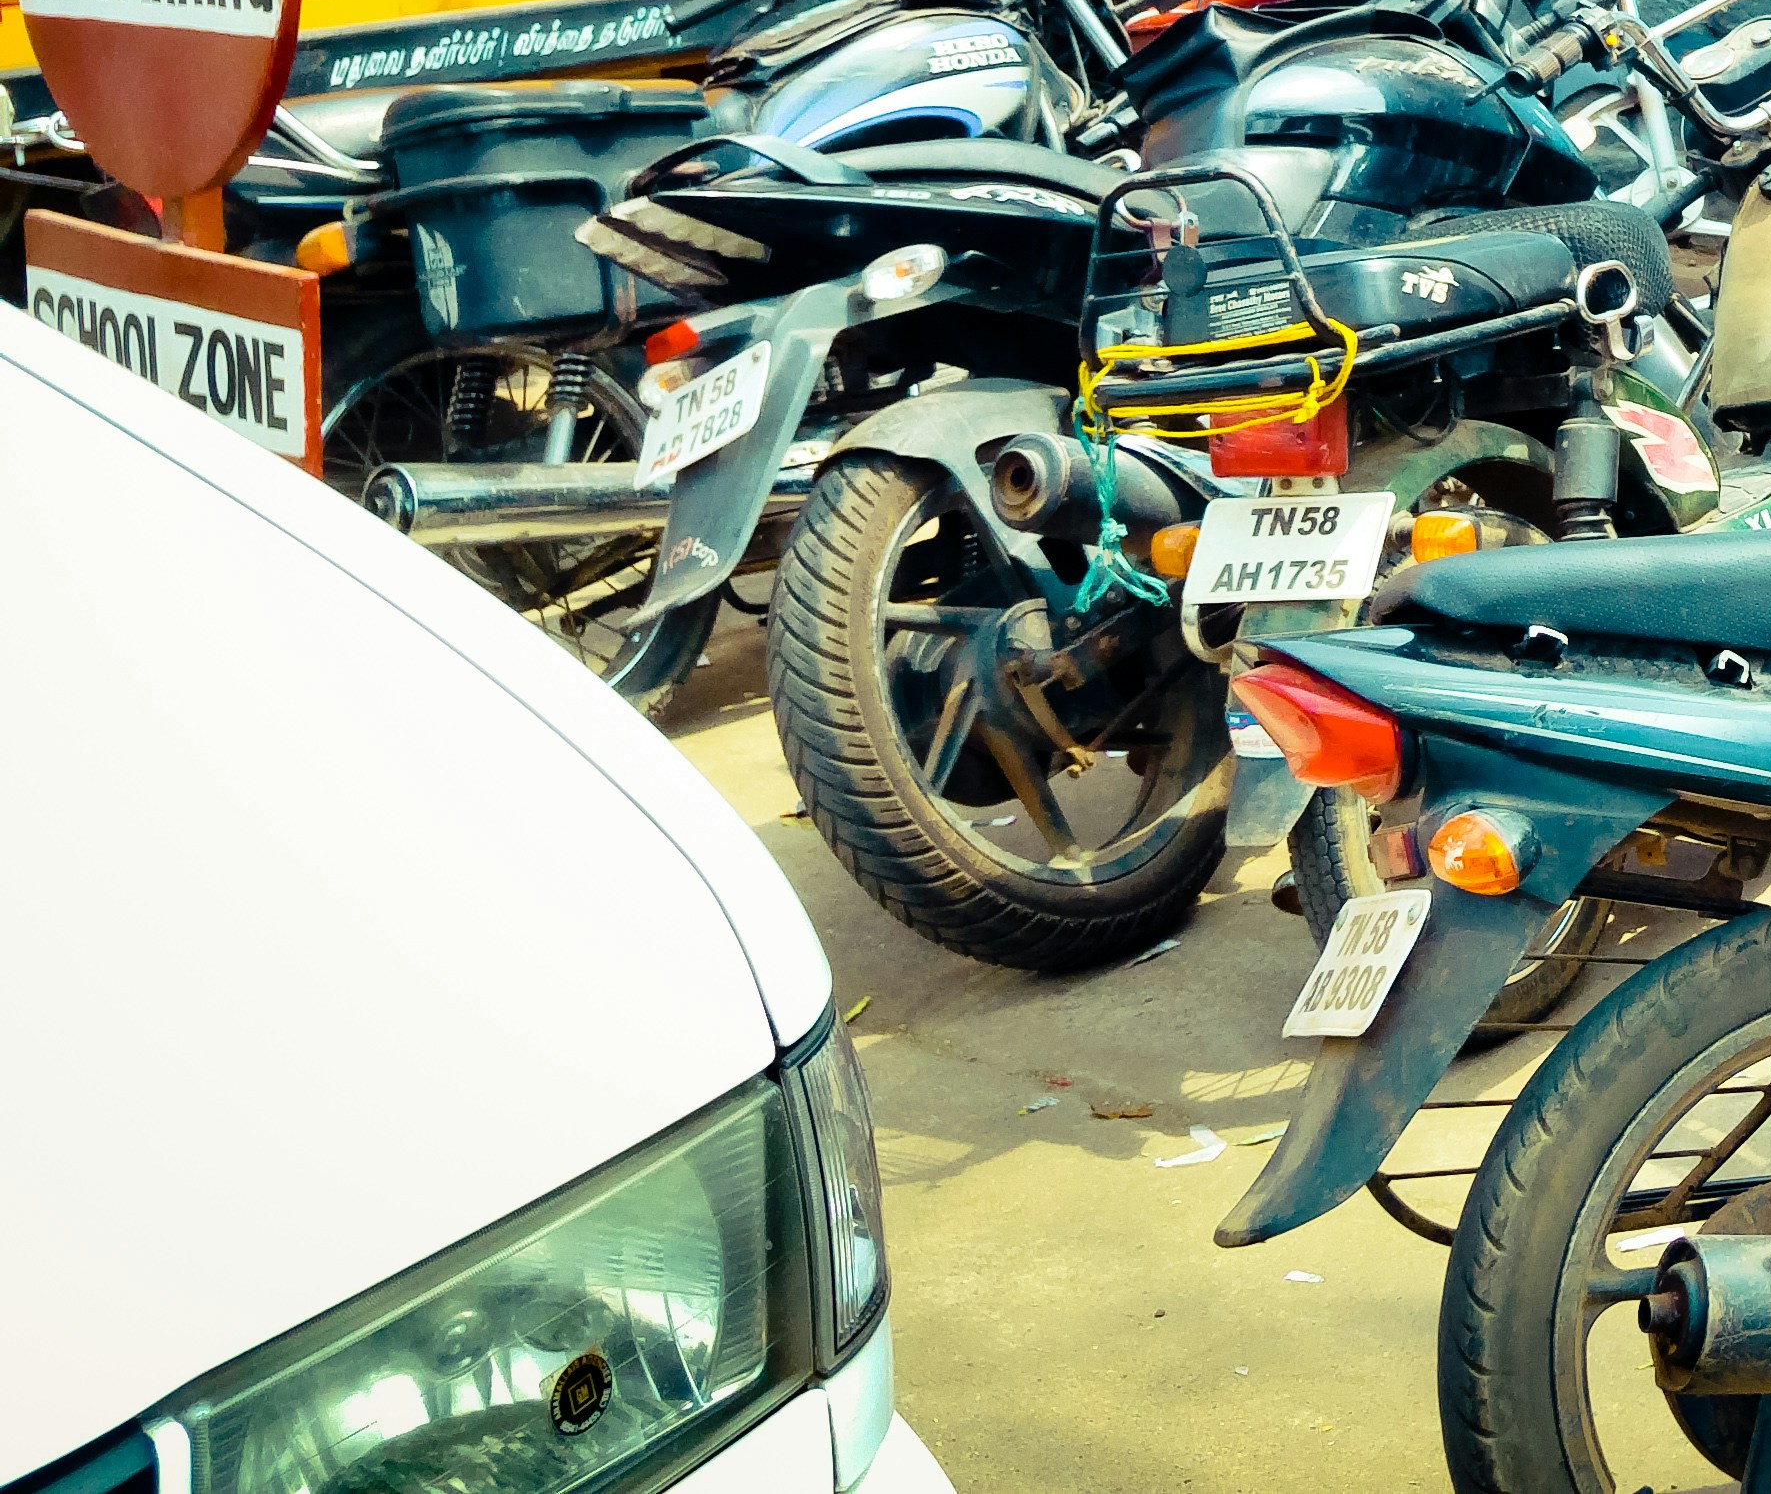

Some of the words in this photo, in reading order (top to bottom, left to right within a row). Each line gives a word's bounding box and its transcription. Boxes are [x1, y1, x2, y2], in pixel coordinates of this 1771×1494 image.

[927, 47, 1023, 74] HONDA
[930, 32, 1010, 57] HERO
[1401, 271, 1449, 304] TVS
[173, 320, 288, 432] ZONE
[675, 383, 706, 424] TN
[709, 367, 738, 405] 58
[688, 399, 743, 453] 7828
[1337, 912, 1374, 957] TN
[1361, 909, 1399, 955] 58
